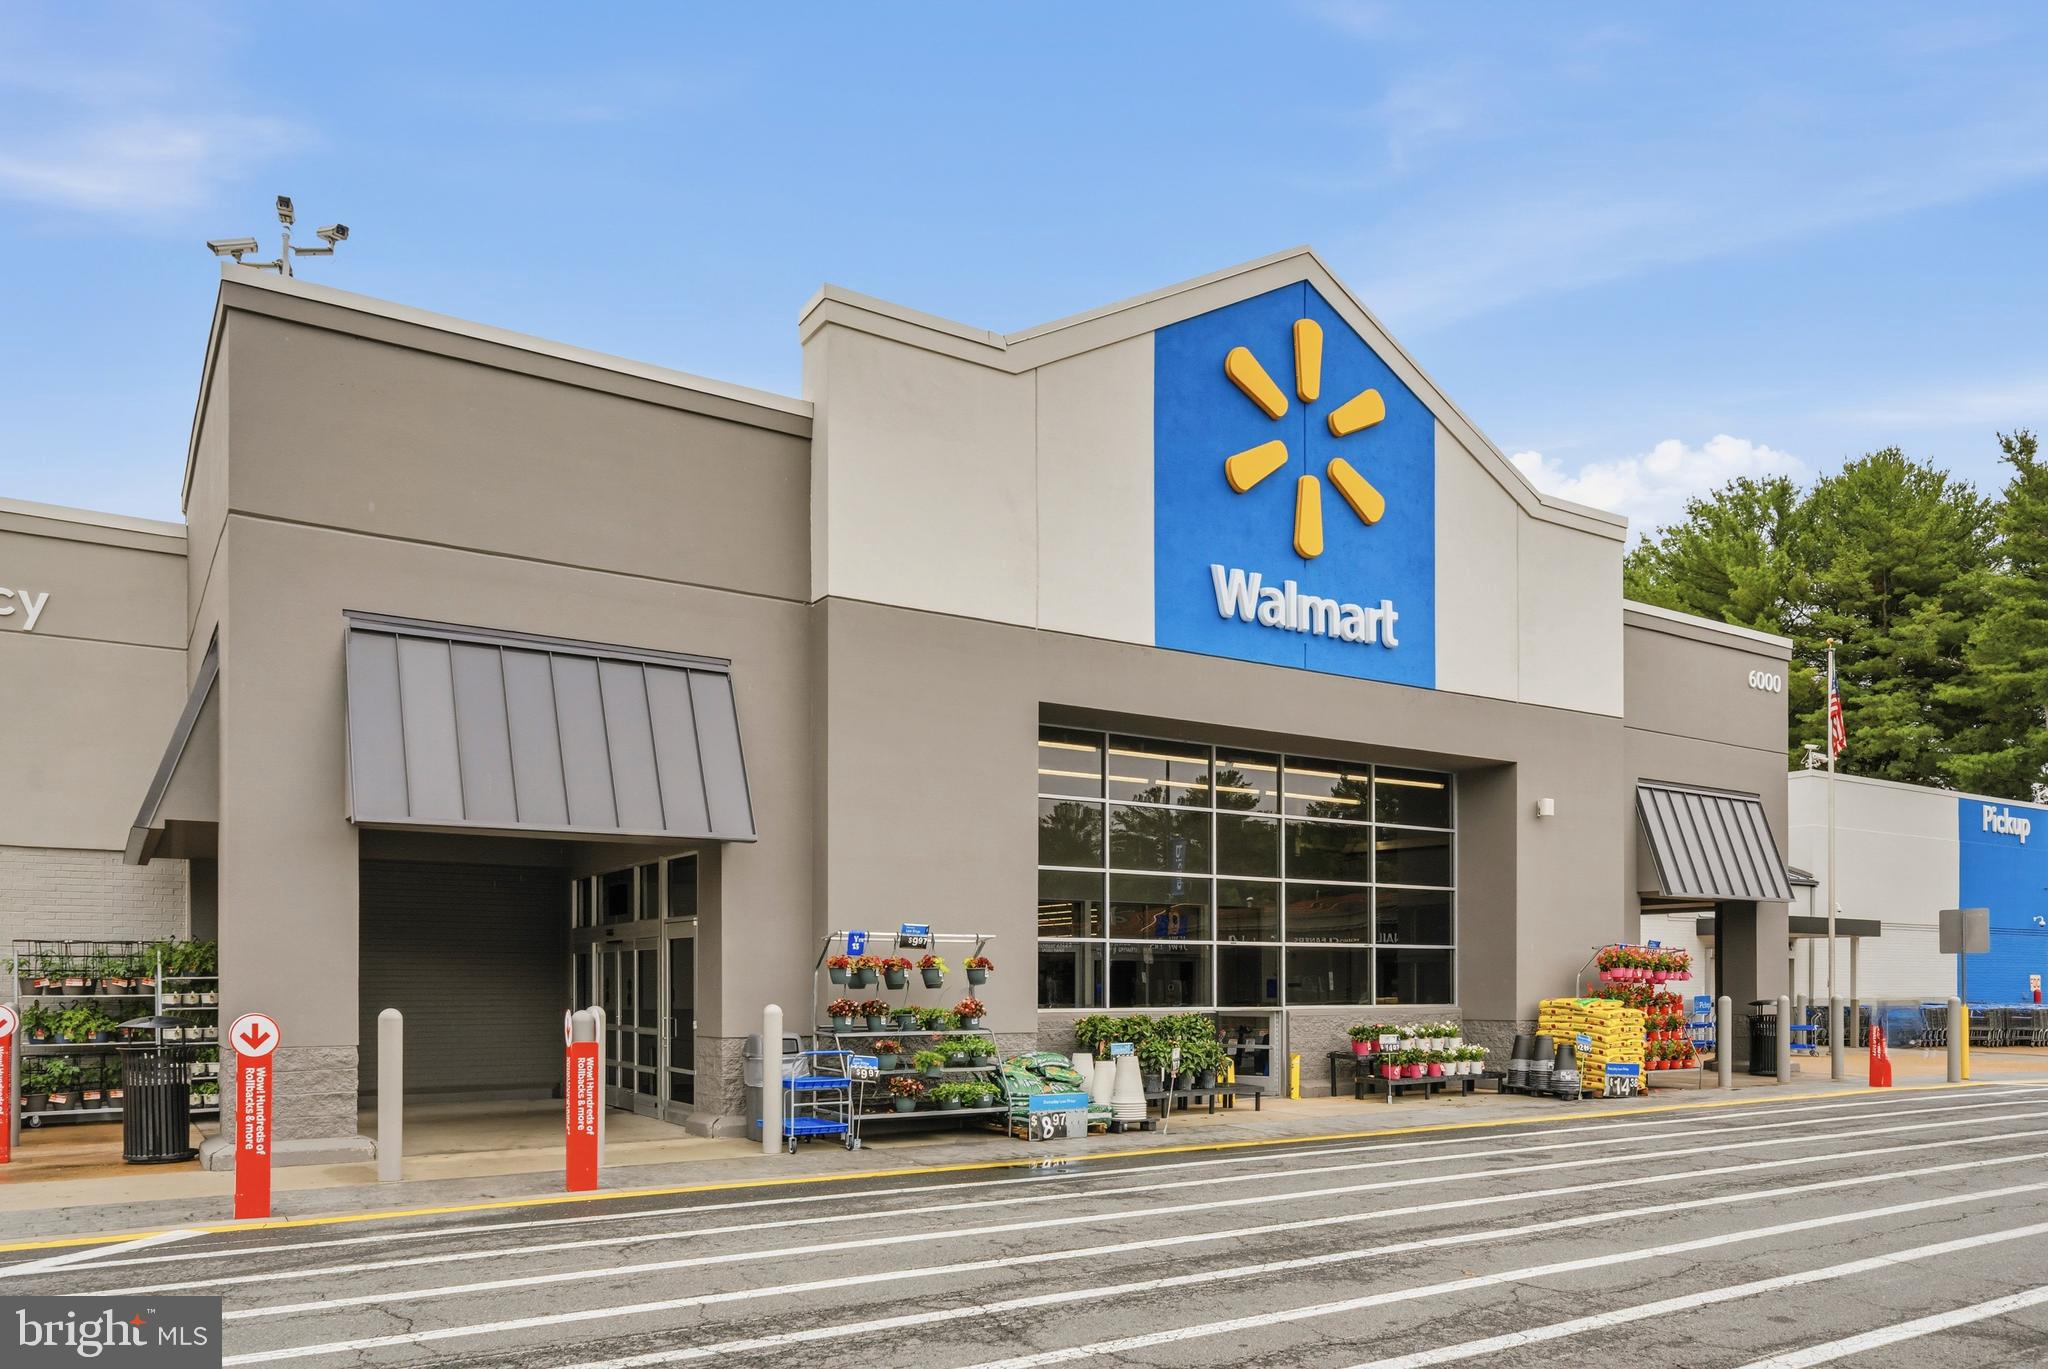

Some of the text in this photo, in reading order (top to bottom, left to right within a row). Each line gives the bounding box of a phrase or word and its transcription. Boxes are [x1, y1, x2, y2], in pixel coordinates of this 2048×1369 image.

[1210, 564, 1399, 649] Walmart
[1749, 670, 1781, 693] 6000
[1983, 804, 2031, 844] Pickup
[245, 1067, 255, 1114] Rollbacks
[577, 1057, 585, 1099] Rollbacks
[586, 1057, 595, 1136] Wow! Hundreds of
[256, 1067, 266, 1155] Wow! Hundreds of
[577, 1107, 585, 1131] more
[245, 1124, 254, 1150] more
